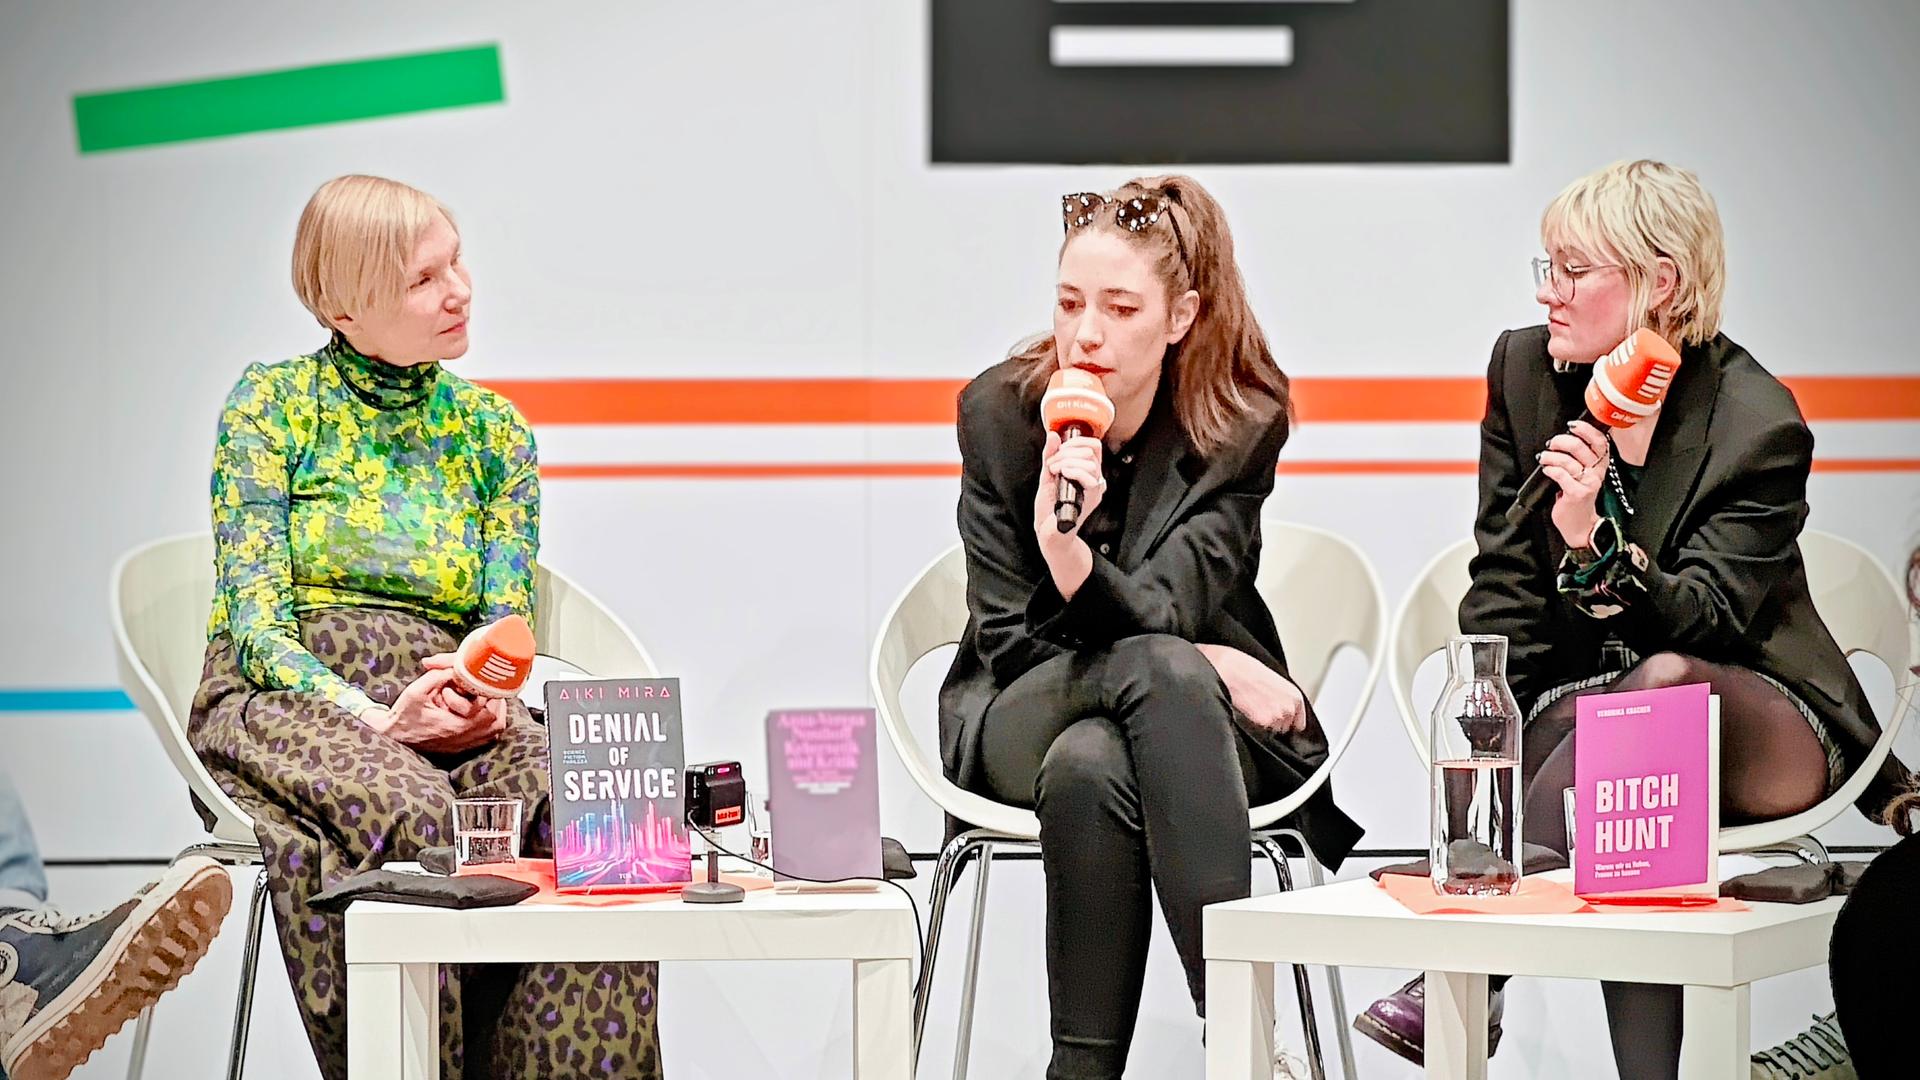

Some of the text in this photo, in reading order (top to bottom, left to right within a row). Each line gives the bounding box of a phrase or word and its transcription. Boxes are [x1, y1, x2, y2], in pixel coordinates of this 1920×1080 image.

[559, 686, 671, 700] AIKI MIRA
[569, 712, 667, 744] DENIAL
[608, 747, 629, 766] OF
[564, 768, 677, 801] SERVICE
[1595, 774, 1679, 813] BITCH
[1595, 815, 1674, 854] HUNT
